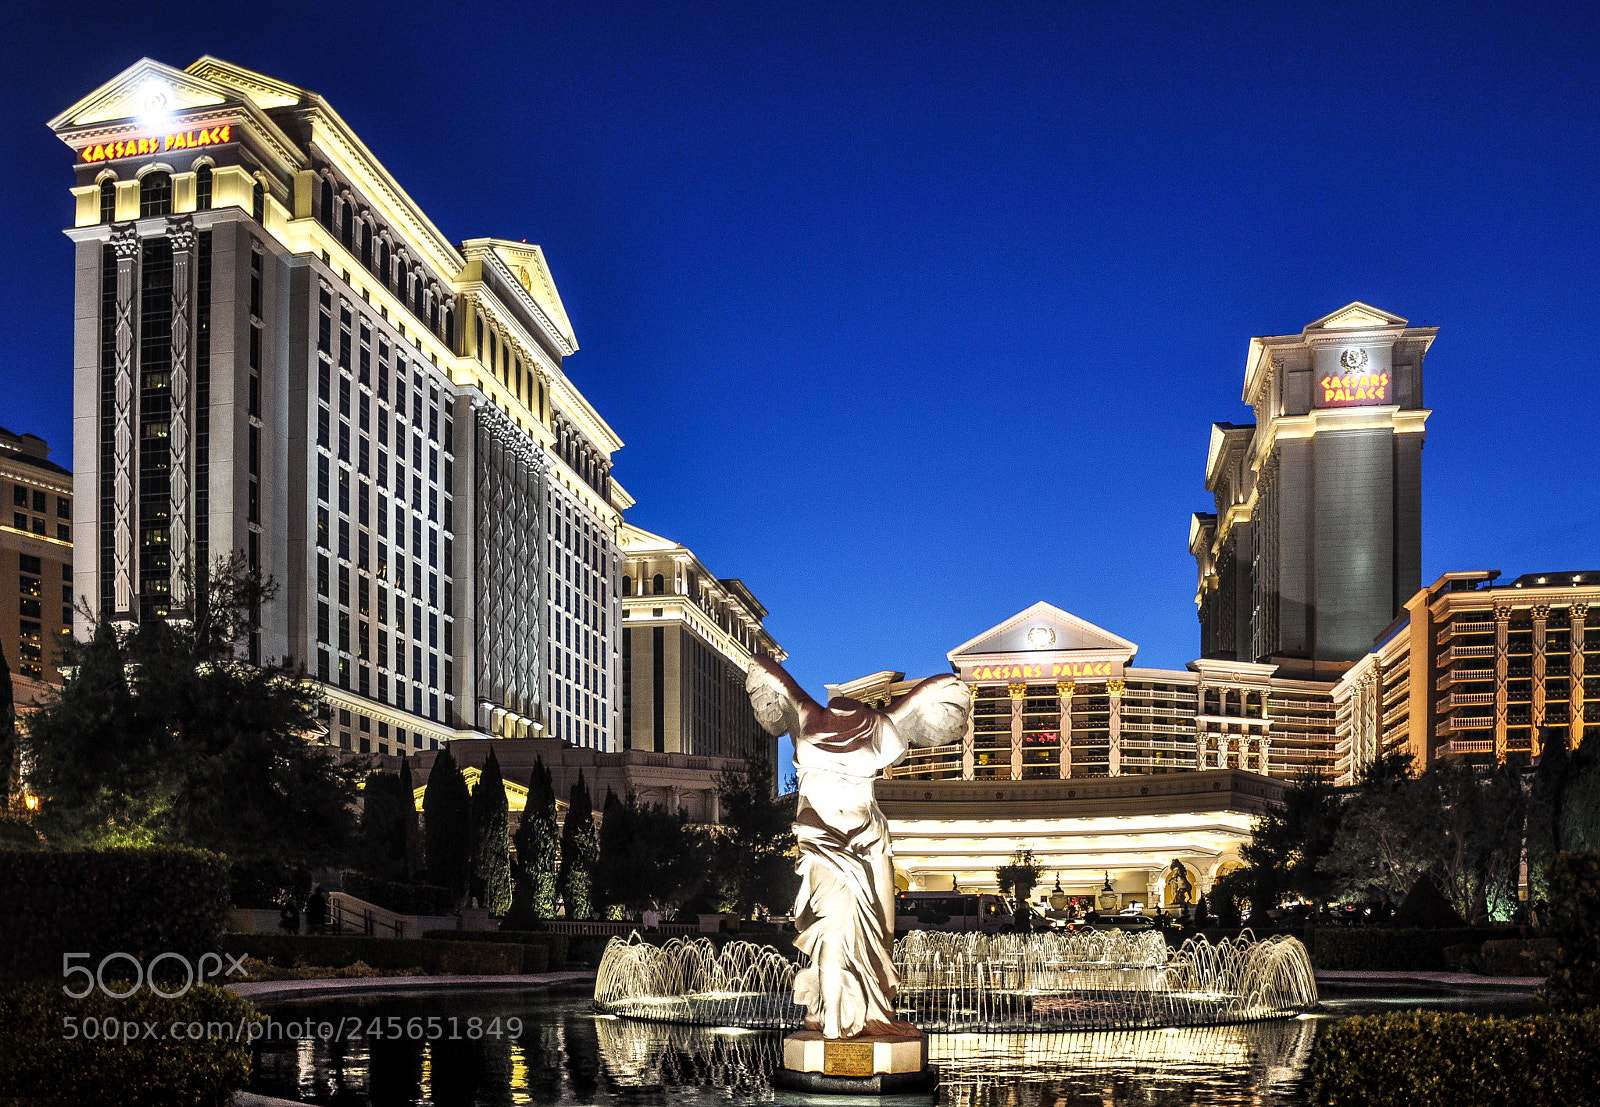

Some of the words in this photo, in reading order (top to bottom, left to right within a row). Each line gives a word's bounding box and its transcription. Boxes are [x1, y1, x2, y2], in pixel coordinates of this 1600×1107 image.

[82, 137, 159, 163] CAESARS
[164, 124, 231, 151] PALACE
[1320, 372, 1389, 390] CAESARS
[1324, 386, 1386, 402] PALACE
[971, 664, 1043, 680] CAESARS
[1052, 663, 1112, 677] PALACE
